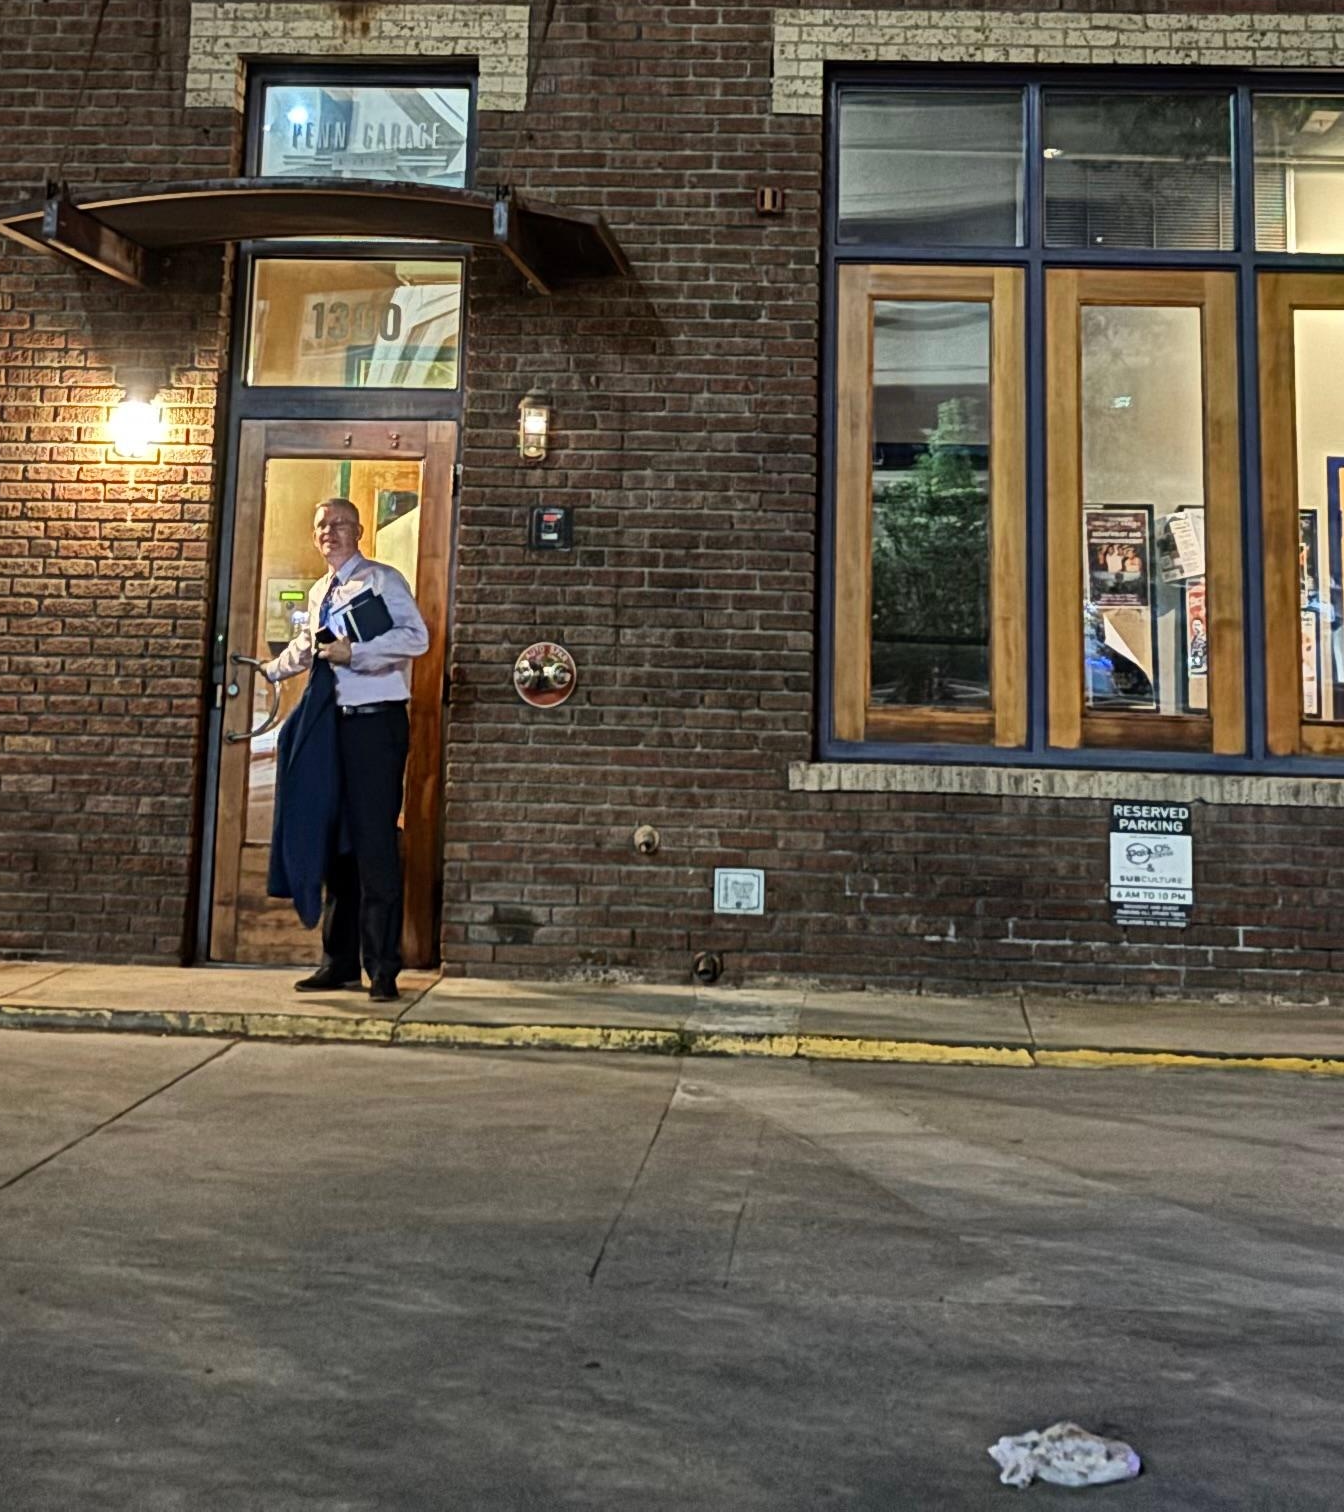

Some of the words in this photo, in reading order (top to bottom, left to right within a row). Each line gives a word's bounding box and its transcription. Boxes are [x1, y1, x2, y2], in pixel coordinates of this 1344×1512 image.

[292, 121, 347, 150] PENN
[363, 122, 441, 150] GARAGE
[312, 300, 402, 342] 1300
[1113, 804, 1189, 819] RESERVED
[1119, 819, 1184, 833] PARKING
[1119, 875, 1183, 884] SUBCULTURE
[1125, 891, 1140, 899] AM
[1143, 892, 1155, 900] TO
[1158, 892, 1168, 900] 10
[1171, 893, 1186, 901] PM
